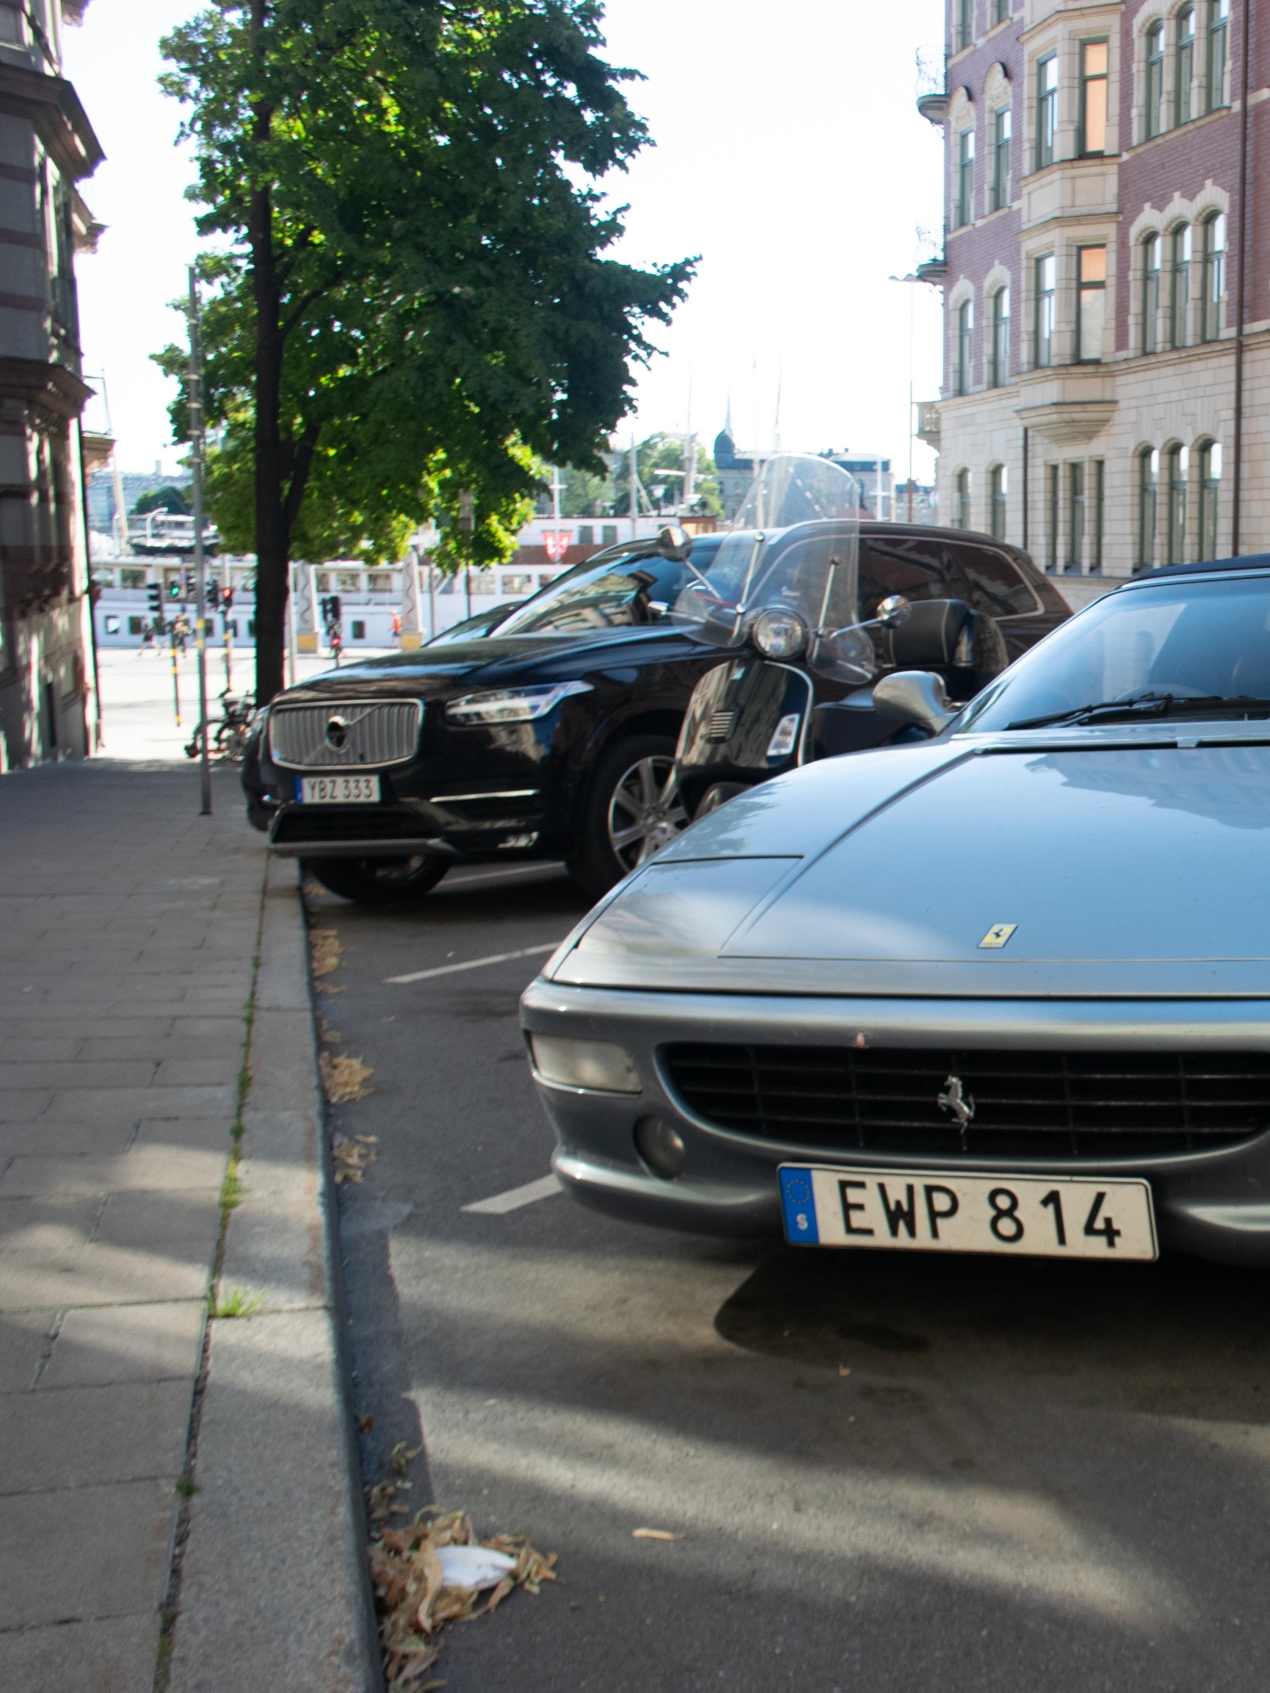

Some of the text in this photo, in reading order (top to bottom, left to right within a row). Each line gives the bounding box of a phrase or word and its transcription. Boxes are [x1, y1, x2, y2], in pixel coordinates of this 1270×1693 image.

[308, 778, 374, 800] YBZ 333
[796, 1179, 1122, 1249] S EWP 814
